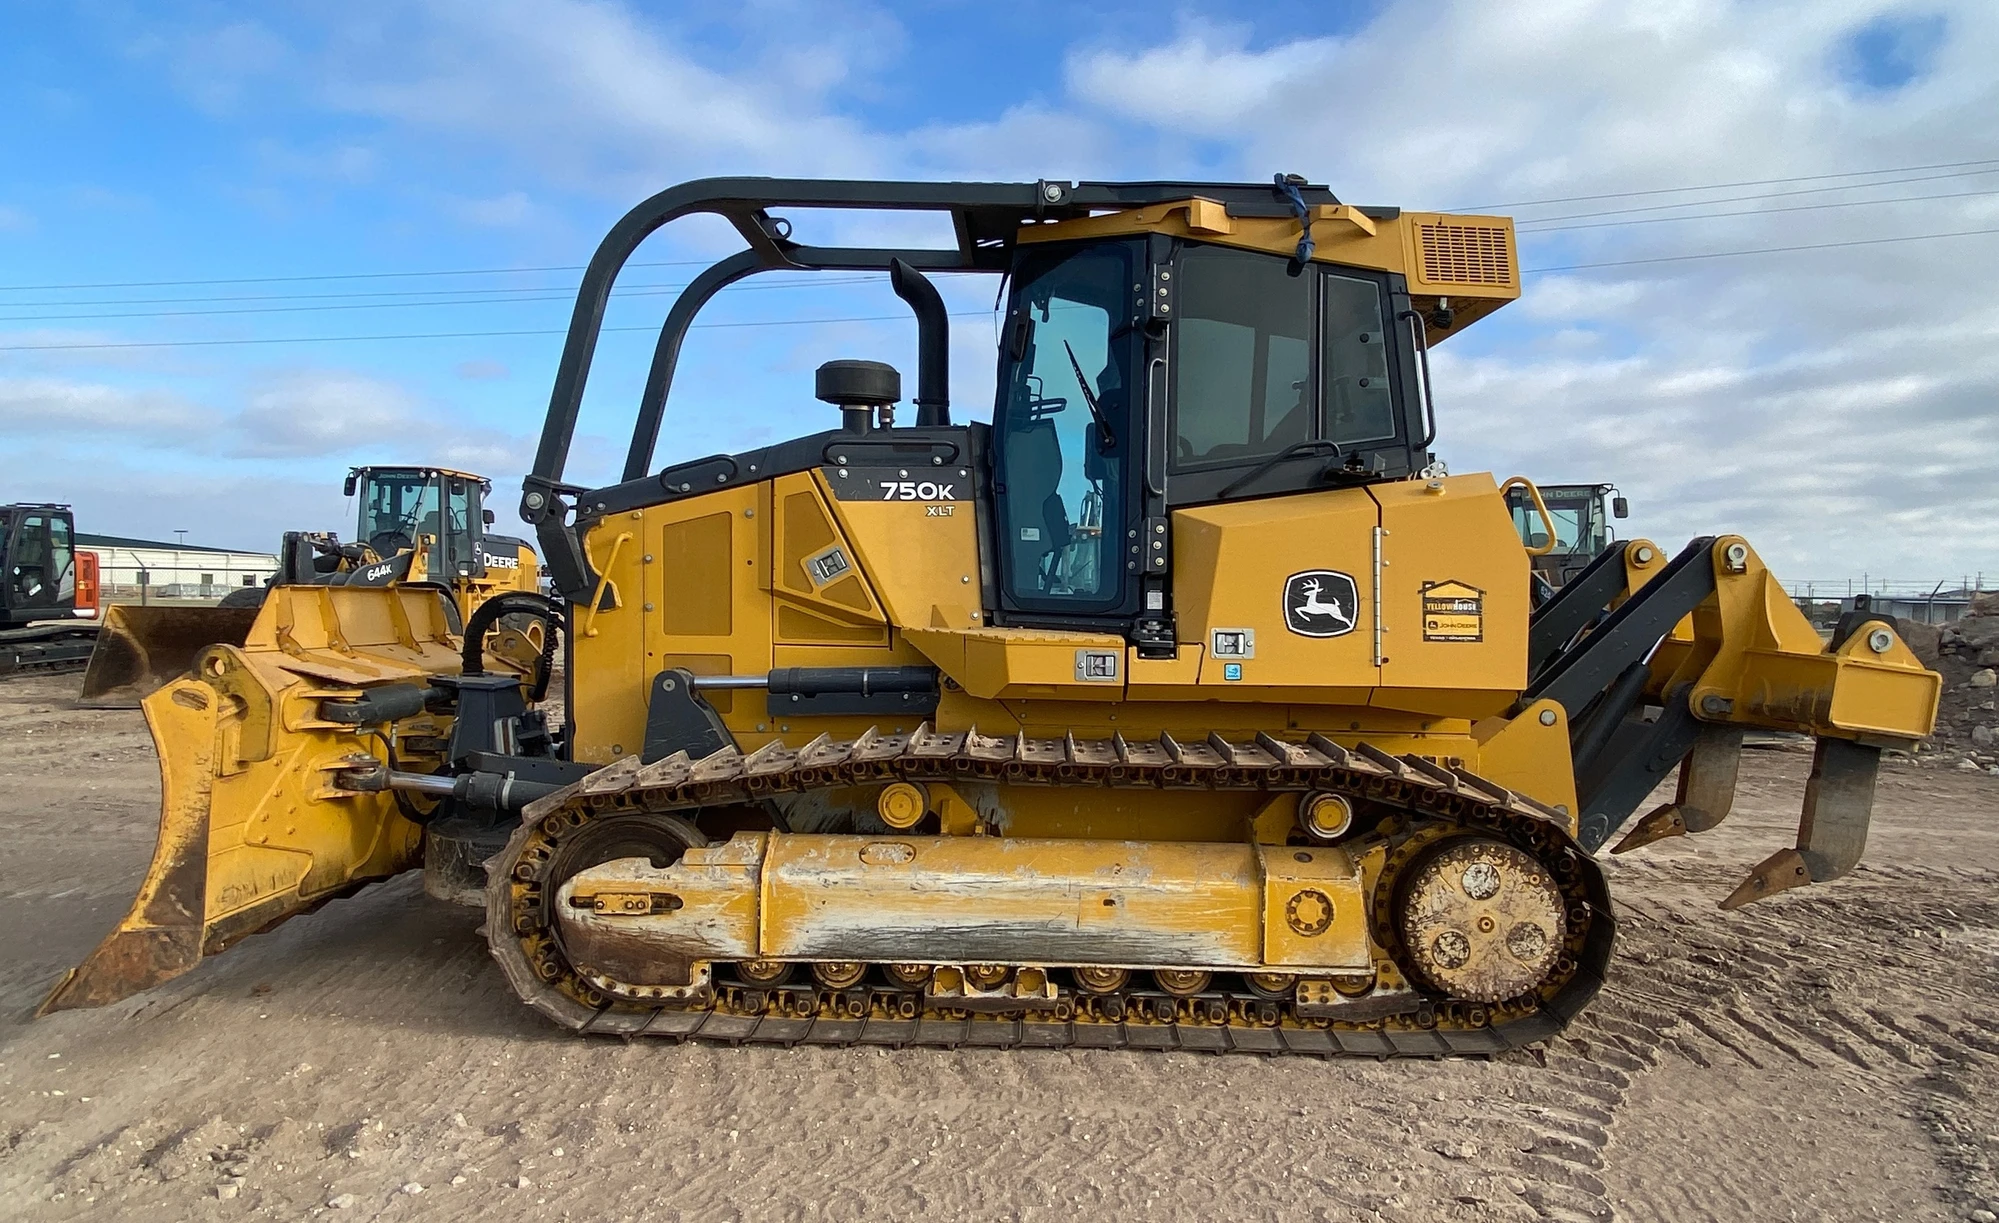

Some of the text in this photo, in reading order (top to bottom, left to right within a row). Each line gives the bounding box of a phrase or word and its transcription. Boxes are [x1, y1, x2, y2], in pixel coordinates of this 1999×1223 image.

[880, 482, 955, 500] 750K
[1525, 490, 1553, 499] JHN
[1555, 490, 1591, 498] DEERE
[926, 505, 955, 517] XLT
[483, 552, 519, 570] DEERE
[367, 564, 393, 581] 644K
